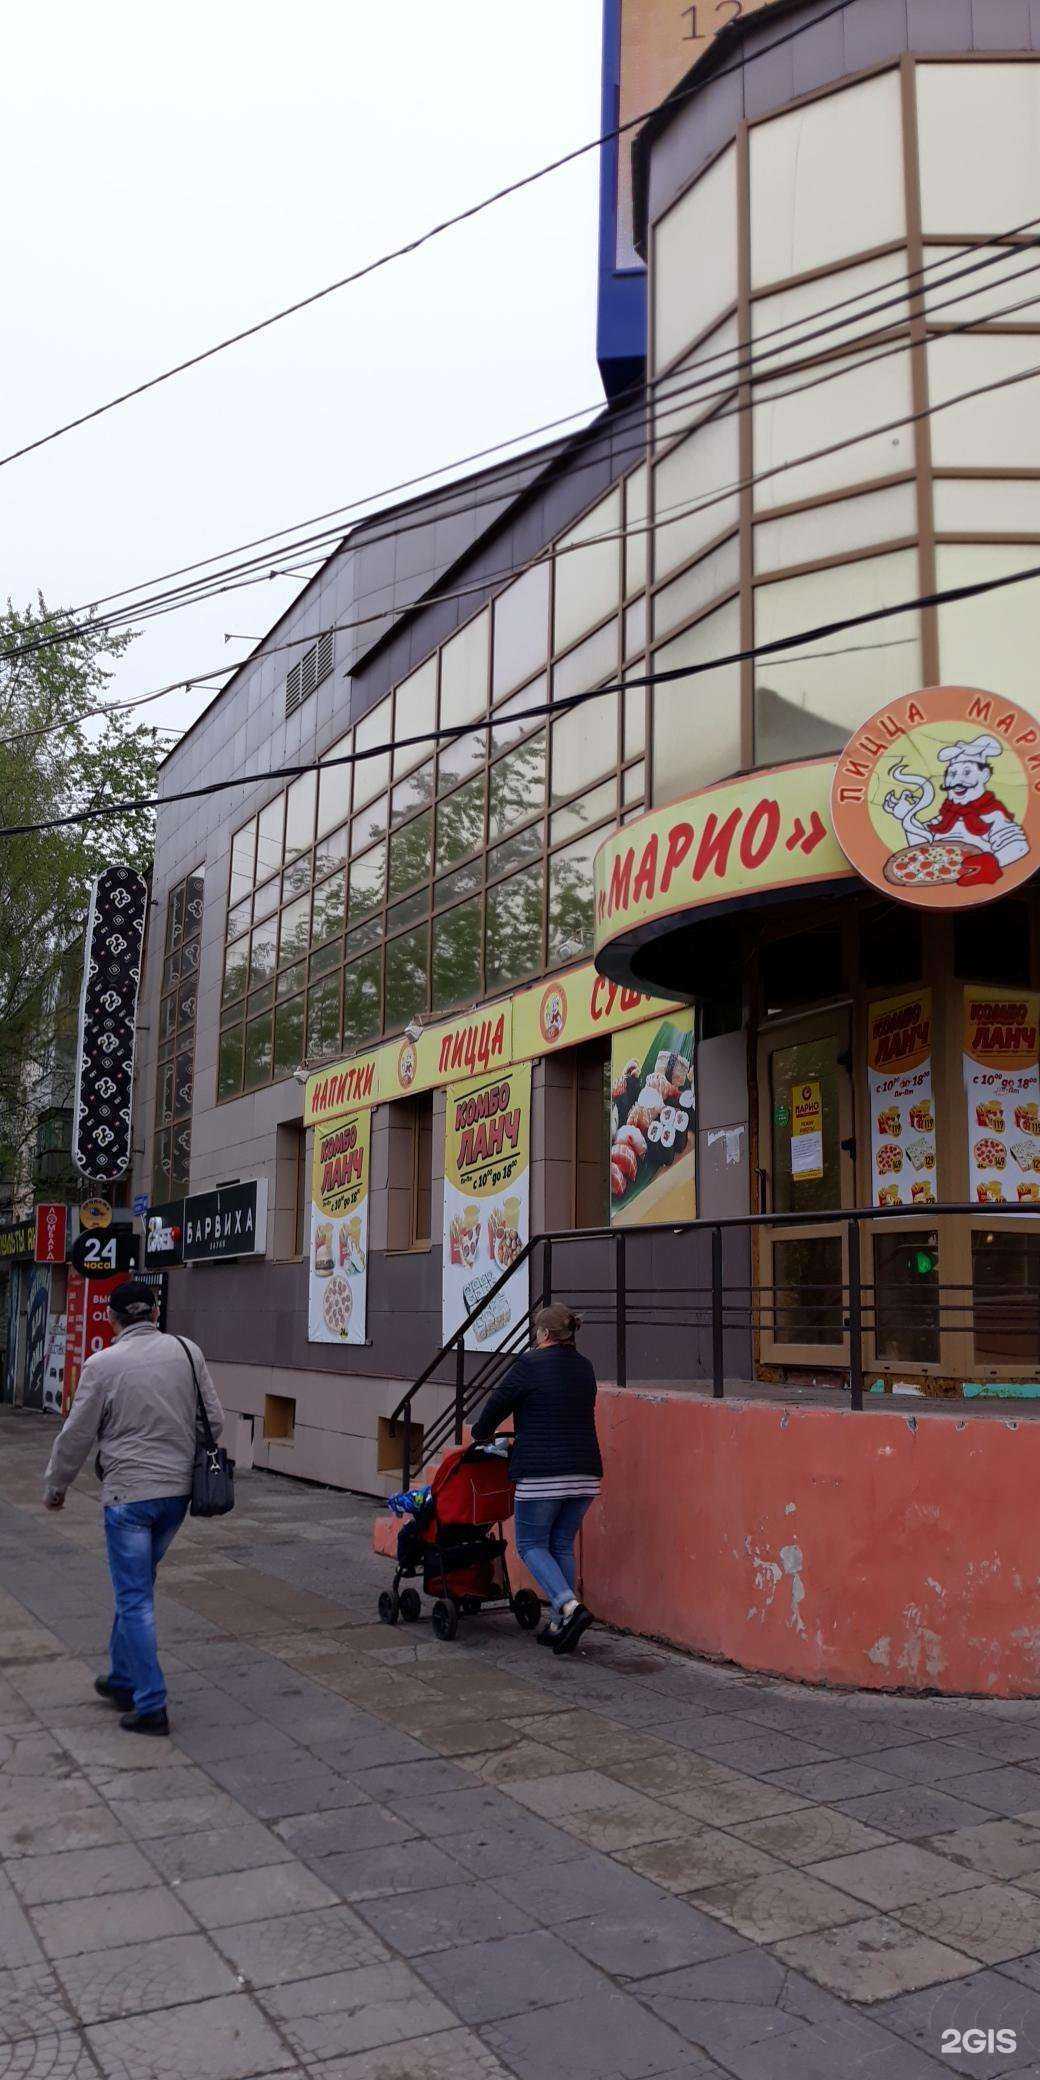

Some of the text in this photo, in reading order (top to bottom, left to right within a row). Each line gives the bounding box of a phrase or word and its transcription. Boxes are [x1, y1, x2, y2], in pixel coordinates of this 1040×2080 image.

[839, 702, 926, 802] ПИЦЦА
[591, 975, 650, 1020] СУШ
[970, 1003, 1028, 1025] КОМБО
[439, 1013, 504, 1073] ПИЦЦА
[873, 1003, 922, 1040] КОМБО
[875, 1018, 930, 1065] ЛАНЧ
[972, 1027, 1036, 1050] ЛАНЧ
[312, 1062, 376, 1113] НАПИТКИ
[455, 1082, 510, 1131] КОМБО
[320, 1125, 358, 1164] КОМБО
[457, 1108, 521, 1170] ЛАНЧ
[321, 1147, 364, 1196] ЛАНЧ
[46, 1206, 58, 1260] ЛОМБАРД
[187, 1207, 253, 1244] БАРВИХА
[84, 1238, 117, 1269] 24
